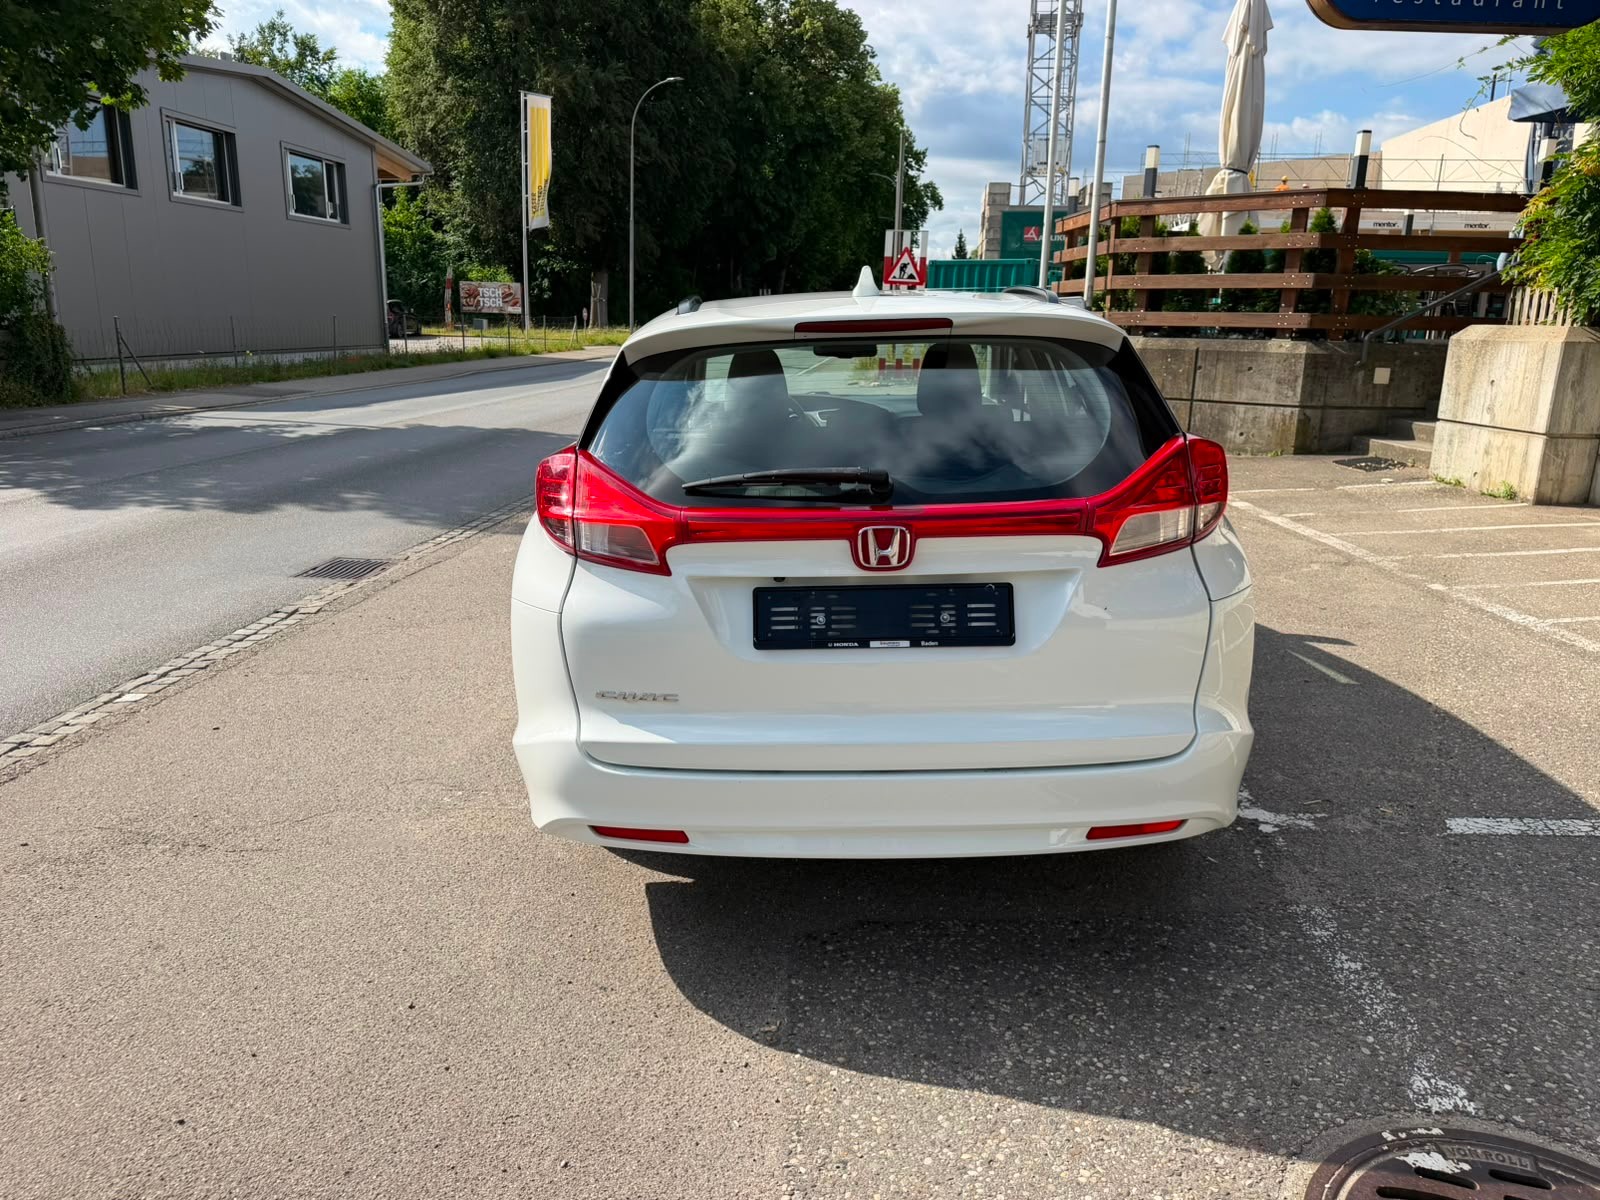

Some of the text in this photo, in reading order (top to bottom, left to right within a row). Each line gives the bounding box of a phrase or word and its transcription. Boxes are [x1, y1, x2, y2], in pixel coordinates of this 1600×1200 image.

[1373, 0, 1564, 10] aurant
[478, 288, 502, 297] TSCH
[479, 298, 502, 307] TSCH
